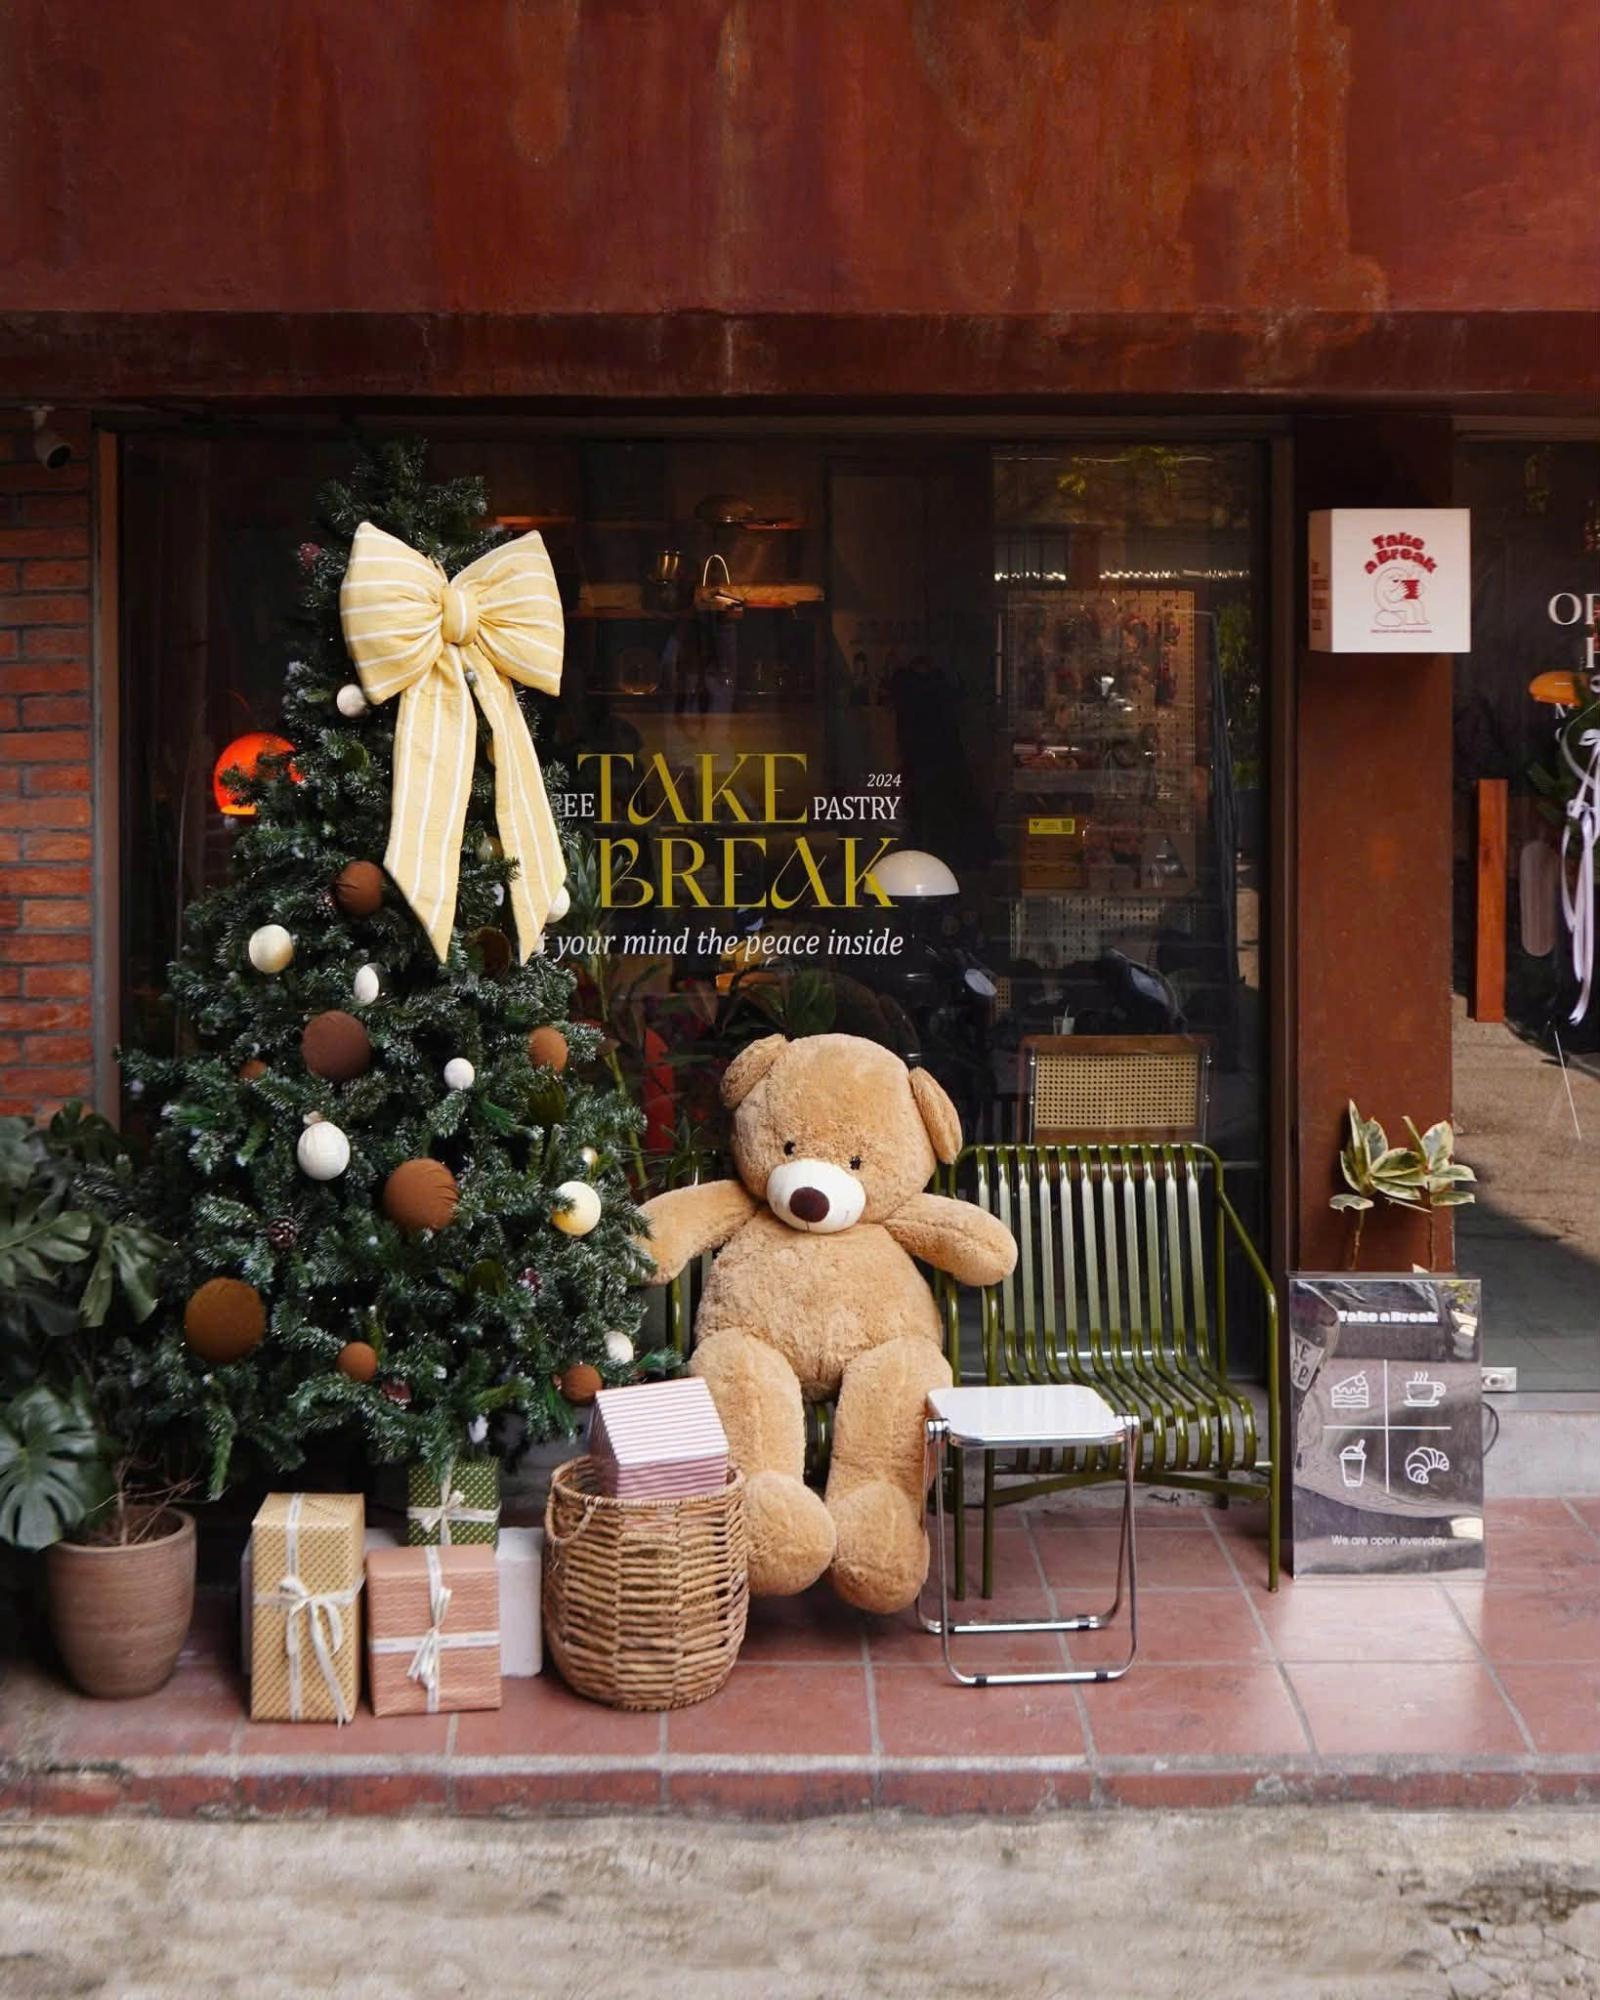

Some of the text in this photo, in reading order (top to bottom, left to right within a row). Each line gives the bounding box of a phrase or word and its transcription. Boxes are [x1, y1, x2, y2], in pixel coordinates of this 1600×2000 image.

[1372, 532, 1425, 550] Take
[1376, 548, 1437, 574] Break
[577, 753, 808, 825] TAKE
[867, 773, 902, 787] 2024
[813, 796, 901, 820] PASTRY
[593, 836, 900, 910] BREAK
[552, 935, 616, 963] your
[623, 927, 690, 956] mind
[697, 927, 738, 955] the
[744, 935, 820, 962] peace
[828, 928, 904, 956] inside
[1337, 1310, 1379, 1323] Take
[1390, 1311, 1438, 1323] Break
[1331, 1535, 1349, 1546] We
[1351, 1537, 1368, 1546] are
[1370, 1536, 1398, 1549] open
